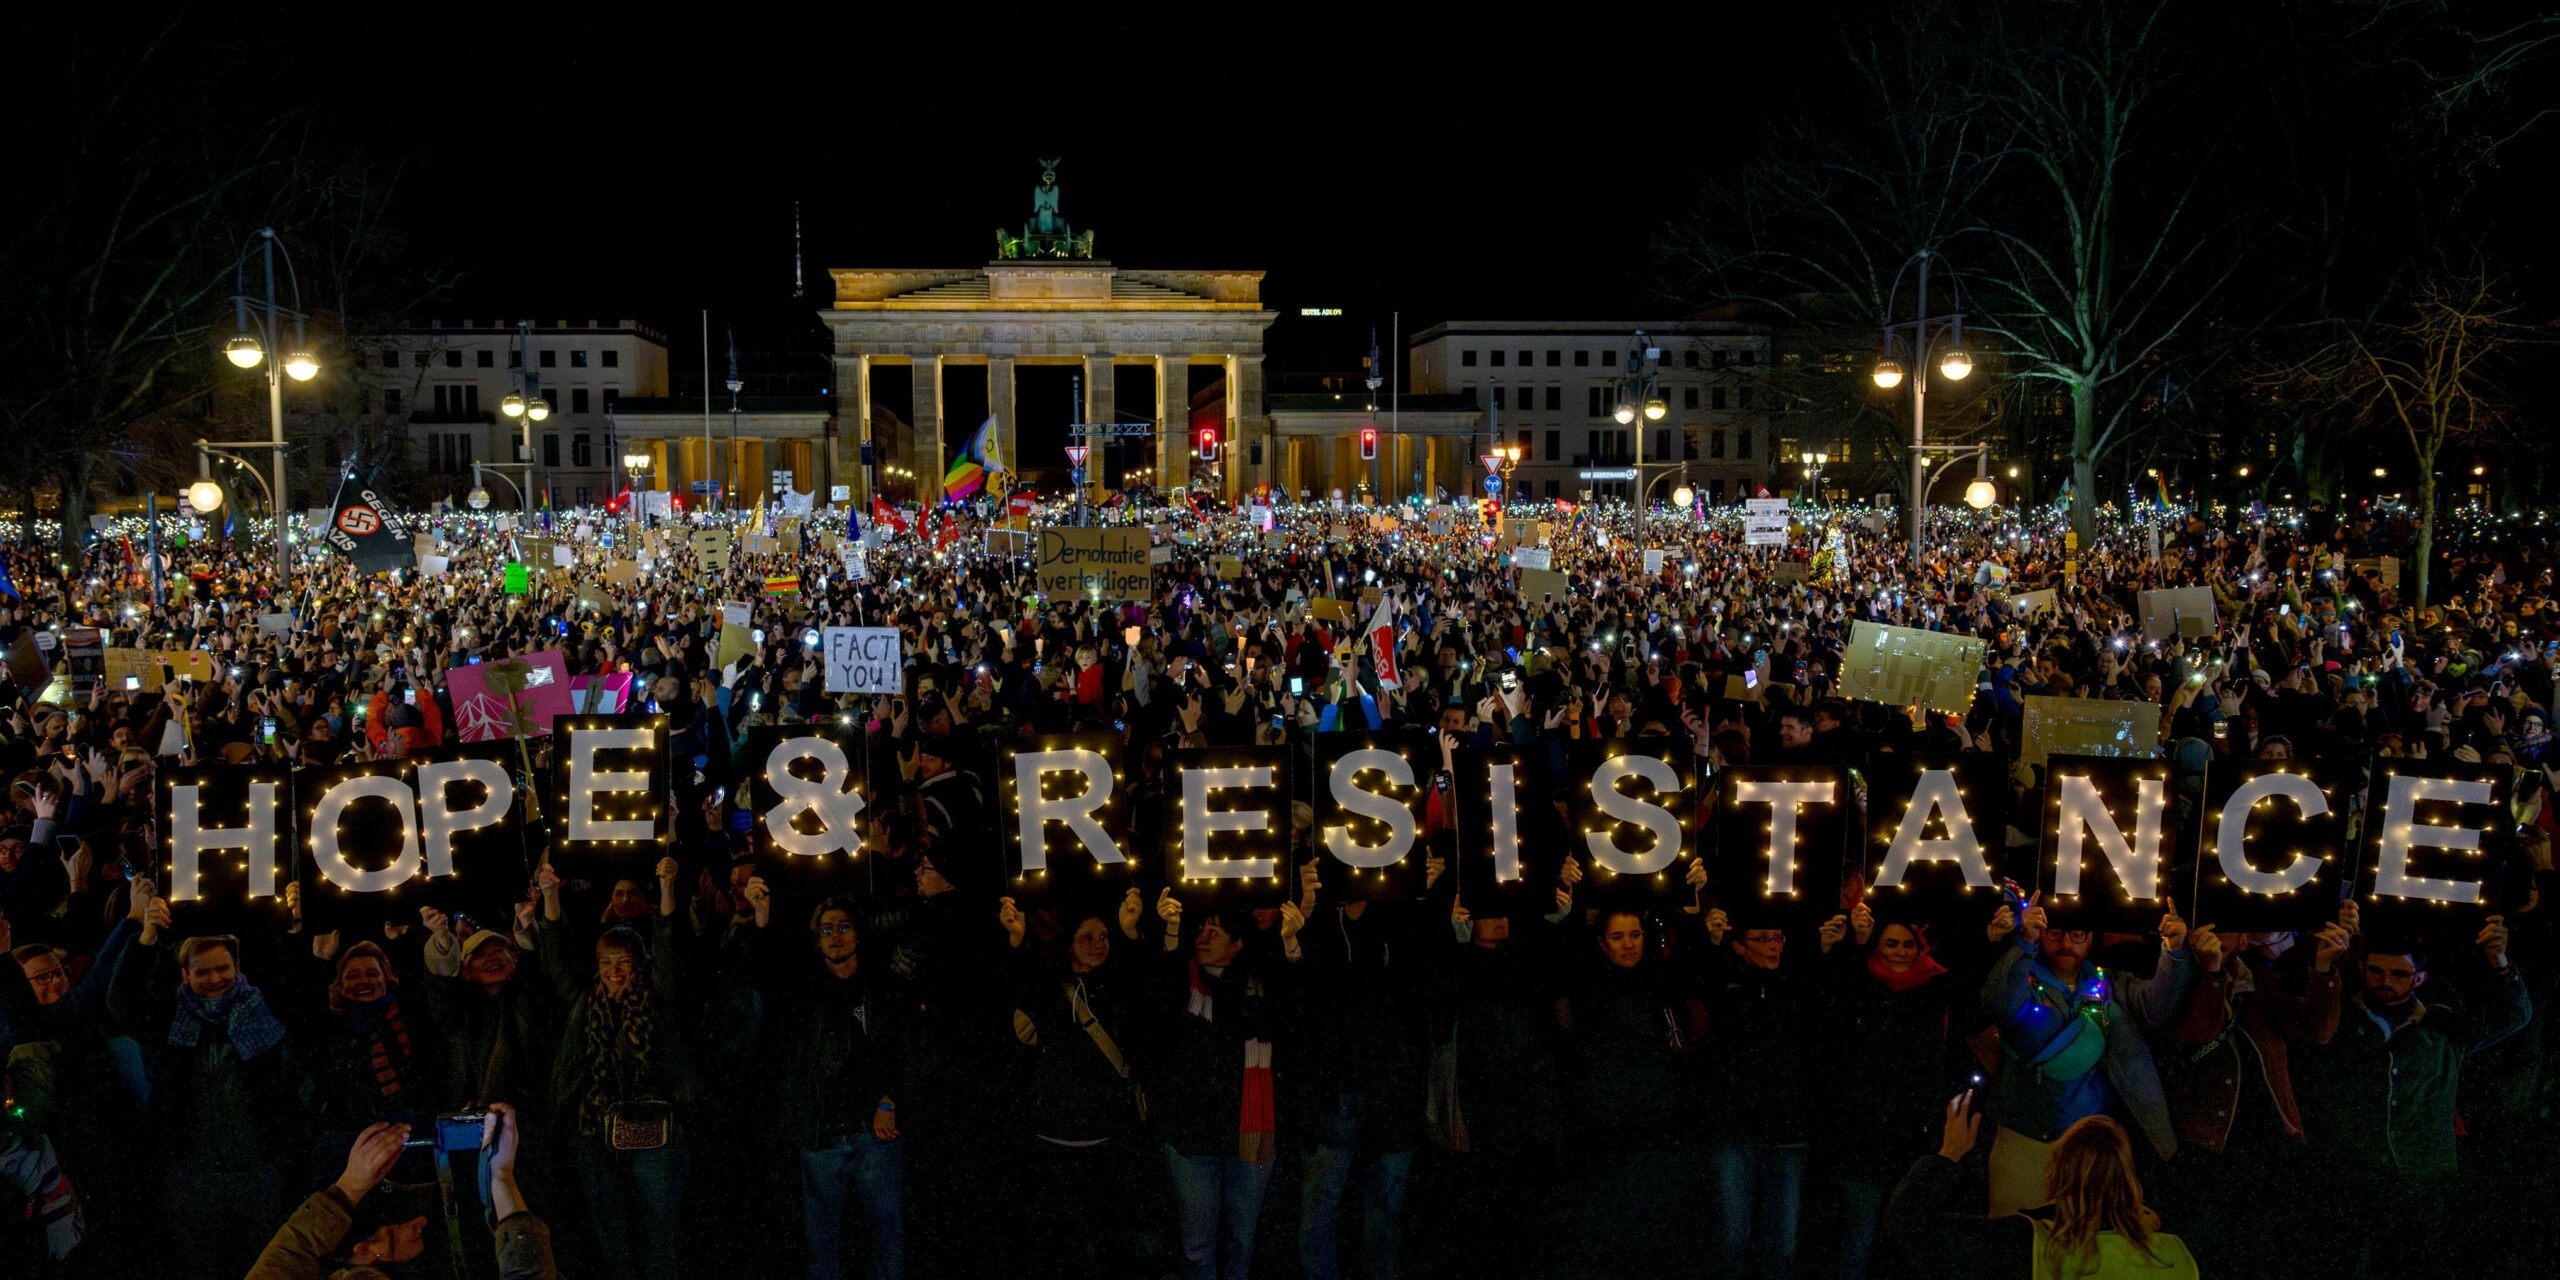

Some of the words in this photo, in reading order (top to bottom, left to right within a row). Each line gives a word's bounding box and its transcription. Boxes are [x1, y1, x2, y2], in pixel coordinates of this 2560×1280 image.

[1301, 308, 1321, 316] HOTEL
[360, 489, 408, 541] GEGEN
[1041, 530, 1145, 565] Demokratie
[1042, 568, 1149, 599] verteidigen
[833, 633, 895, 662] FACT
[169, 727, 656, 902] HOPE
[764, 736, 866, 857] &
[1012, 748, 2493, 903] RESISTANCE
